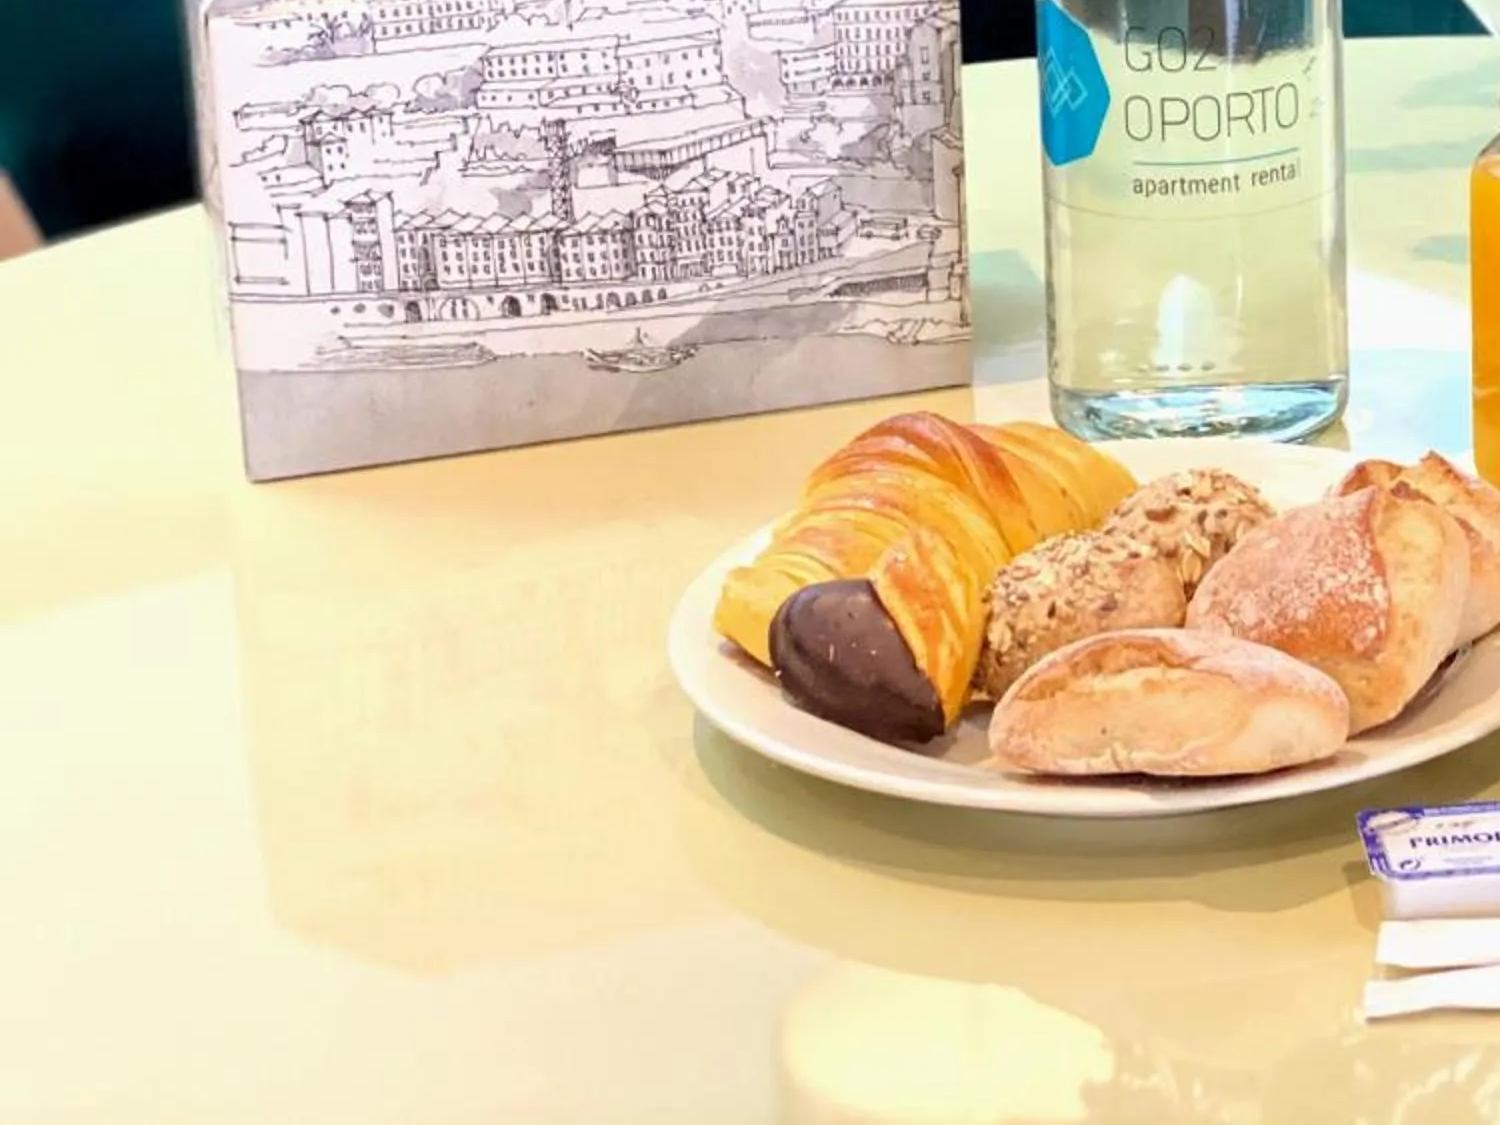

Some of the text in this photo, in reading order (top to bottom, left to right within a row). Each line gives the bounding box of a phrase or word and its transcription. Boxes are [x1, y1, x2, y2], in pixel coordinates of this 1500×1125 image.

[1124, 27, 1217, 73] GO2
[1125, 82, 1299, 142] OPORTO
[1133, 173, 1240, 197] apartment
